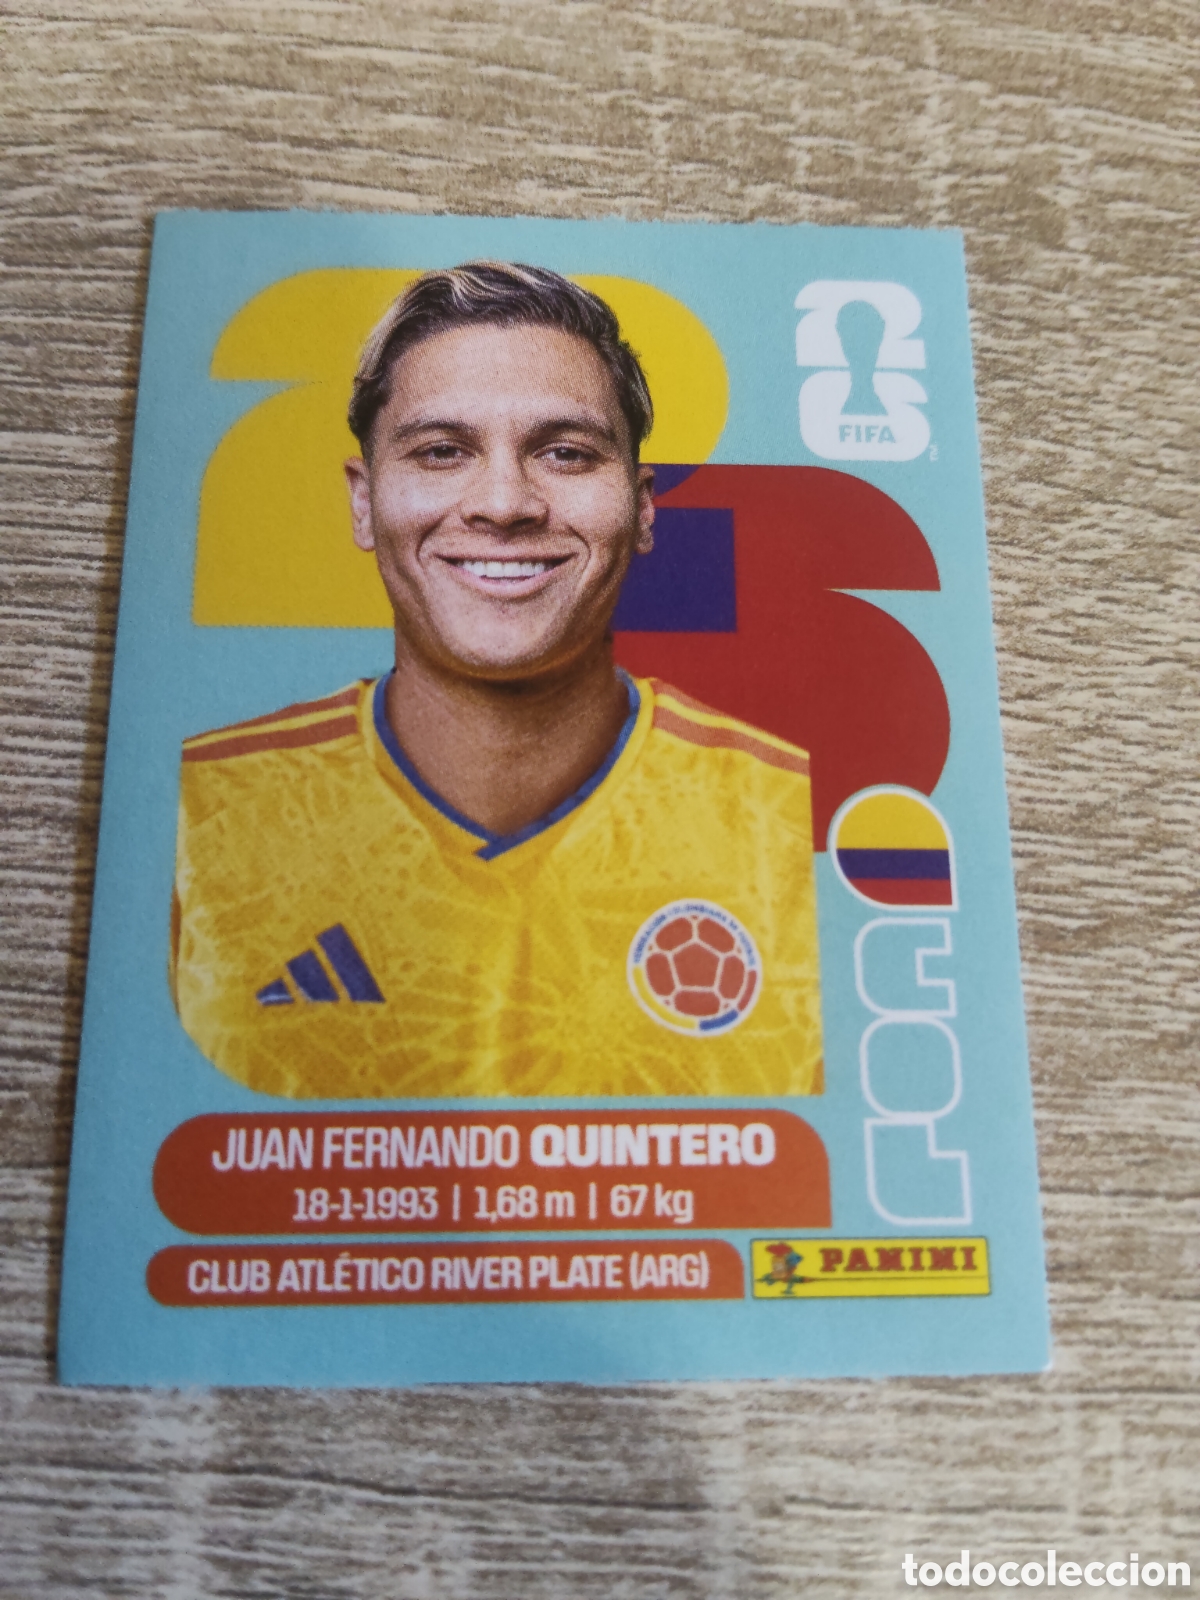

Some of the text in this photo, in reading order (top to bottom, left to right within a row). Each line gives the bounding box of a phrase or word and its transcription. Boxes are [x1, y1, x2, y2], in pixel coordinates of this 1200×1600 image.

[838, 424, 897, 443] FIFA
[212, 1122, 776, 1171] JUAN FERNANDO QUINTERO
[292, 1188, 439, 1221] 18-1-1993
[474, 1186, 539, 1223] 1,68
[545, 1191, 576, 1217] m
[610, 1184, 649, 1218] 67
[654, 1184, 694, 1223] kg
[187, 1251, 710, 1293] CLUB ATLÉTICO RIVER PLATE (ARG)
[818, 1247, 978, 1273] PANINI
